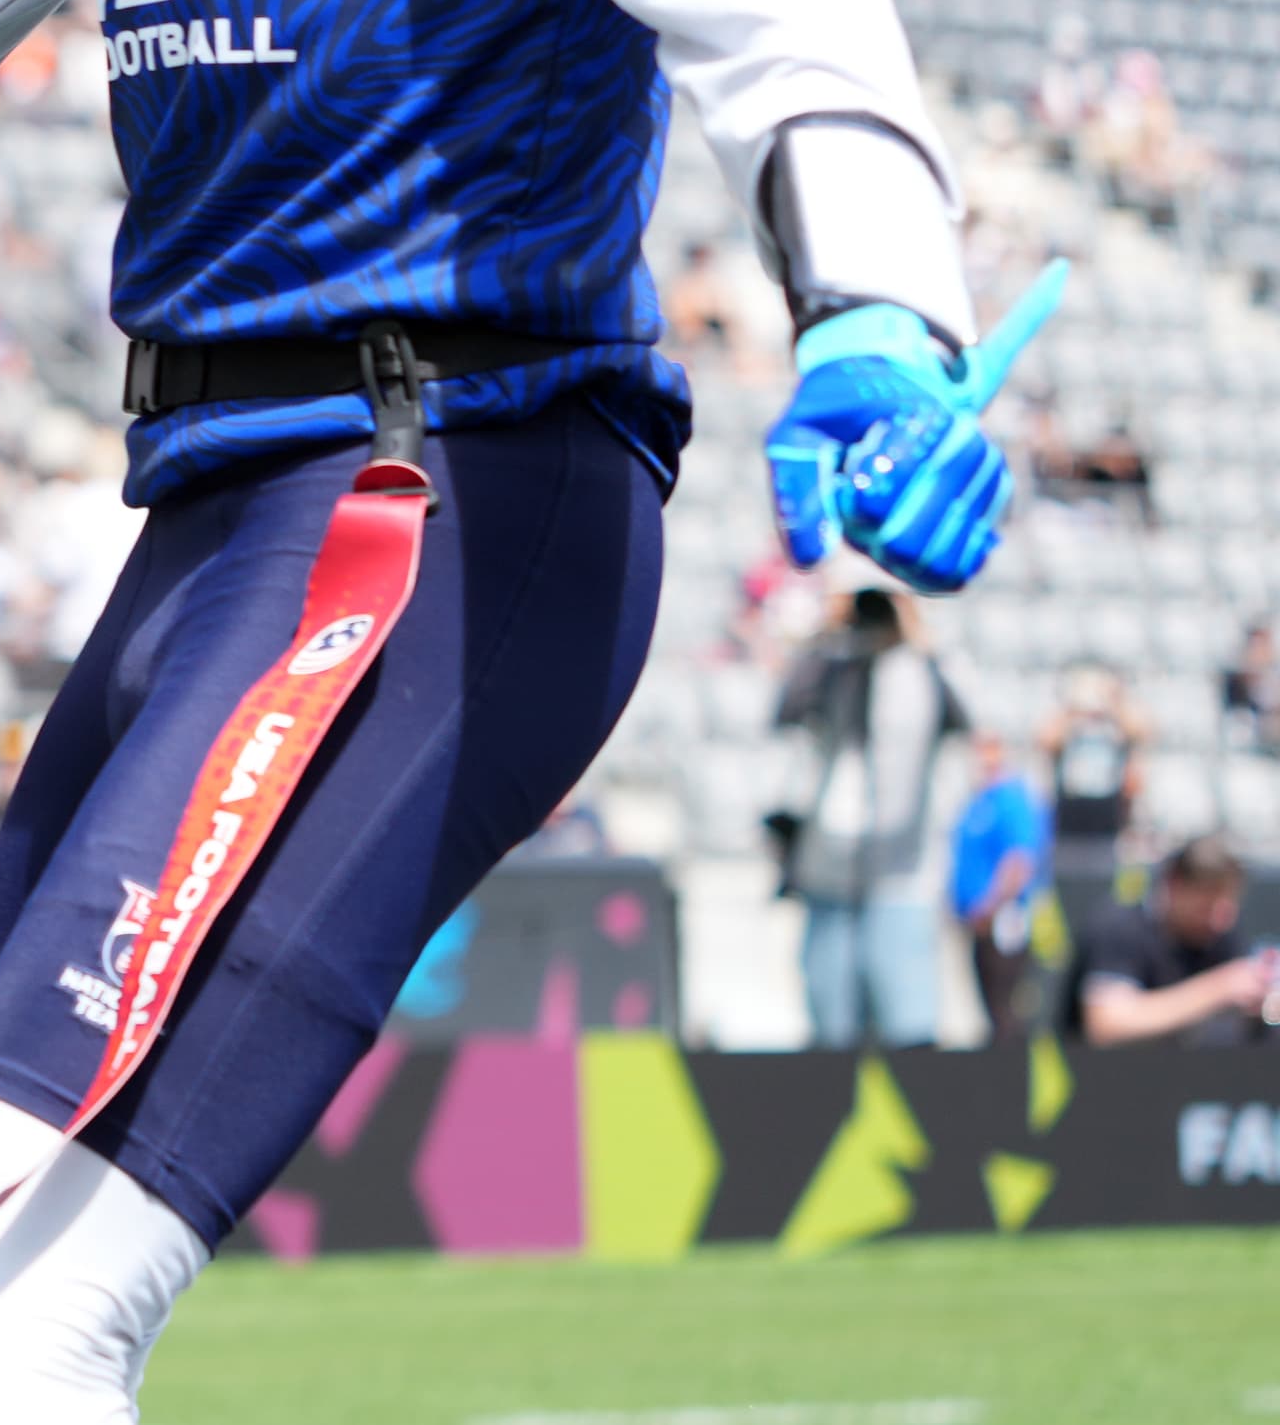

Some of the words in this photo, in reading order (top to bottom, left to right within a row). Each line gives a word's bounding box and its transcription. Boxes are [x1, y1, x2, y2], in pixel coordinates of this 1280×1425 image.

[104, 17, 298, 82] OOTBALL
[222, 711, 295, 804] USA
[110, 810, 243, 1074] FOOTBALL
[73, 993, 119, 1031] TEA
